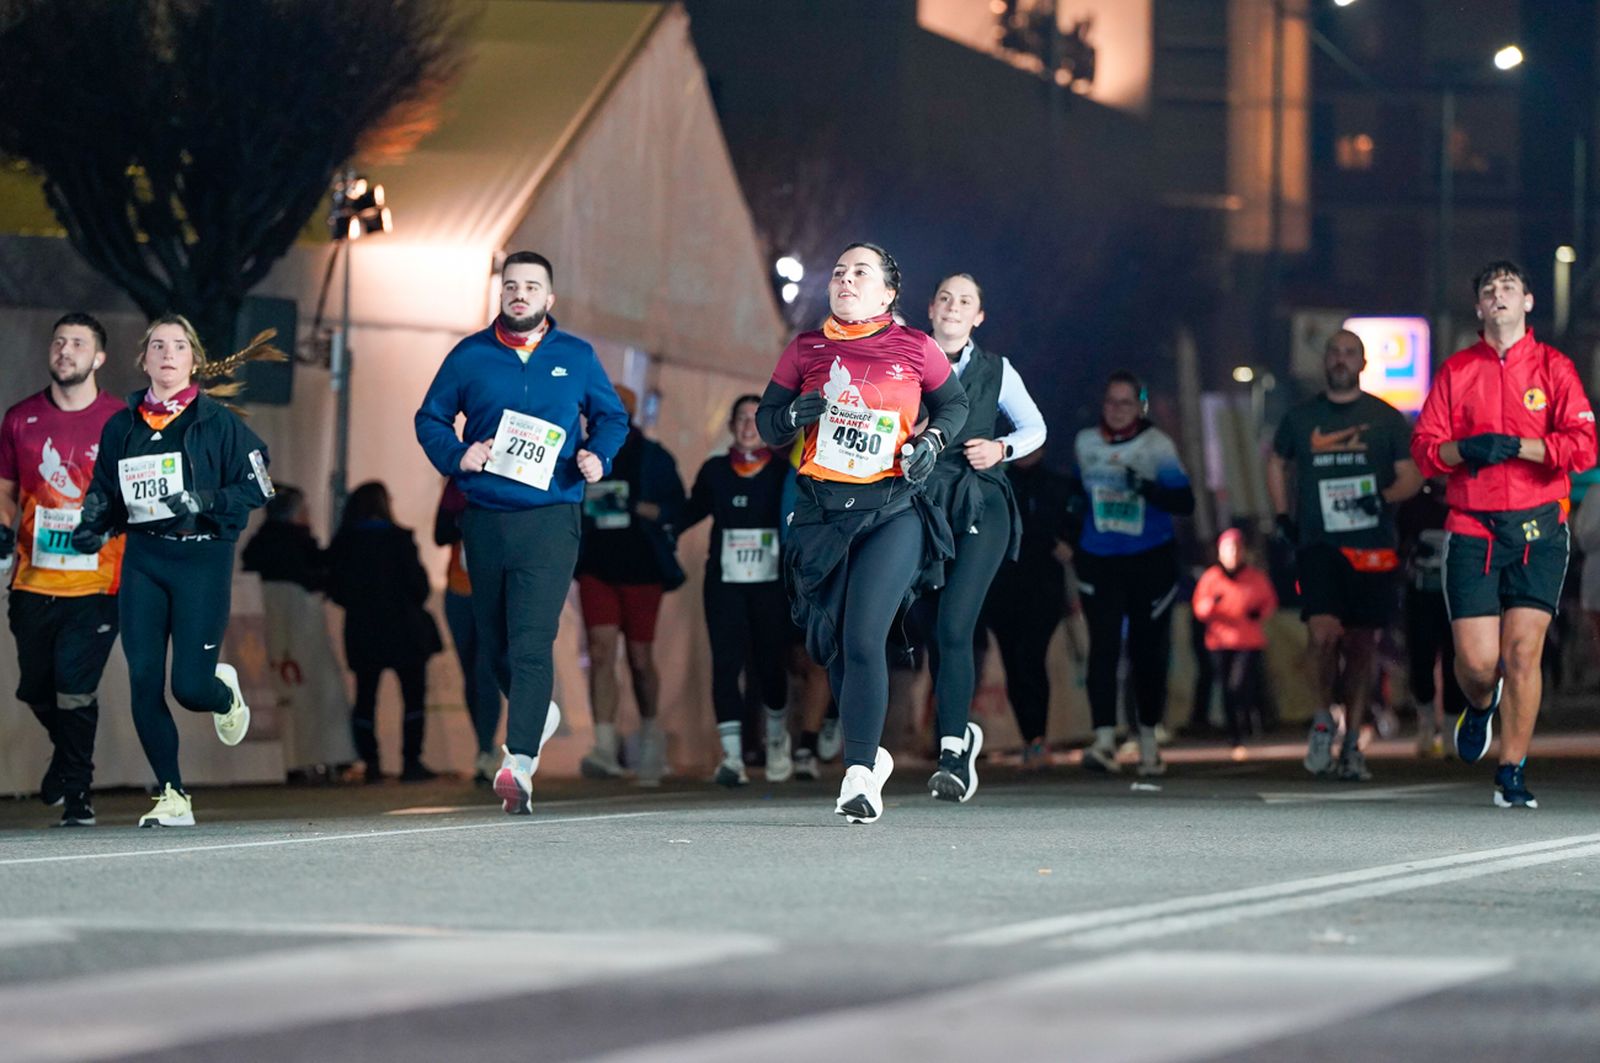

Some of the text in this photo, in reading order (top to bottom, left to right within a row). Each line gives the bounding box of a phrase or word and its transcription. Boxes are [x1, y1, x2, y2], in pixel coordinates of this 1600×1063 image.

[829, 416, 846, 425] SAN
[506, 436, 546, 464] 2739
[832, 426, 882, 455] 4930
[51, 471, 67, 488] 43
[132, 477, 168, 500] 2738
[48, 530, 71, 549] 777
